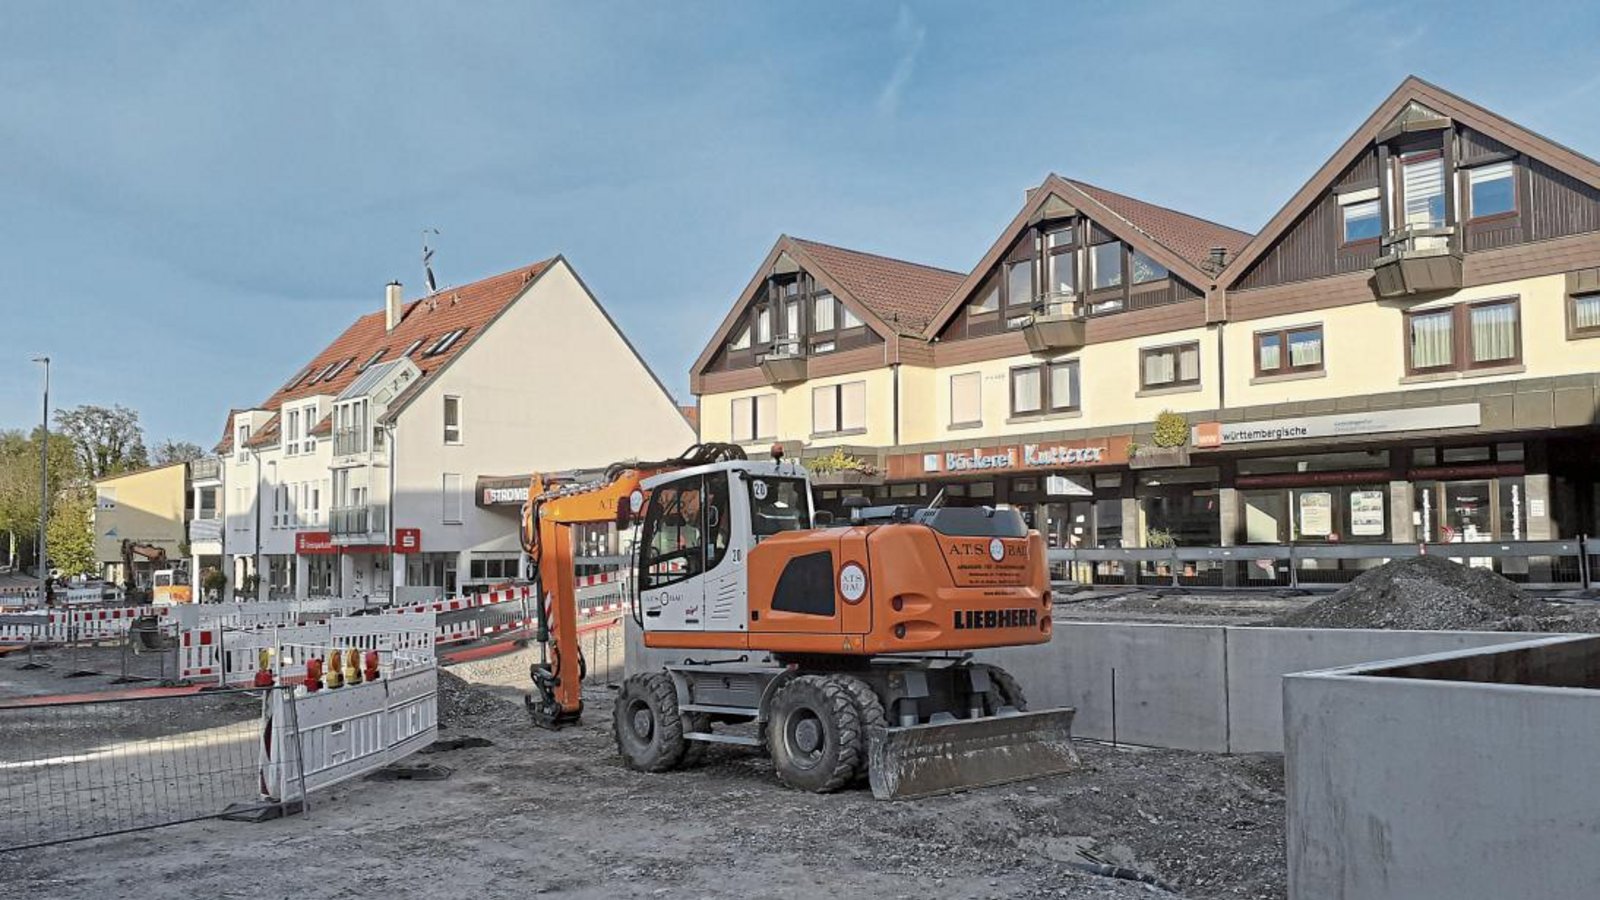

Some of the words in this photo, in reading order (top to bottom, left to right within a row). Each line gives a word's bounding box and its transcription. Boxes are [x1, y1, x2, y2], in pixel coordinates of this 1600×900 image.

[1223, 426, 1307, 441] württembergische
[945, 448, 1017, 471] Bäckerei
[1024, 444, 1105, 466] Kutterer
[491, 488, 528, 502] STROMB
[754, 483, 766, 495] 20
[732, 549, 741, 561] 20
[954, 608, 1037, 629] LIEBHERR
